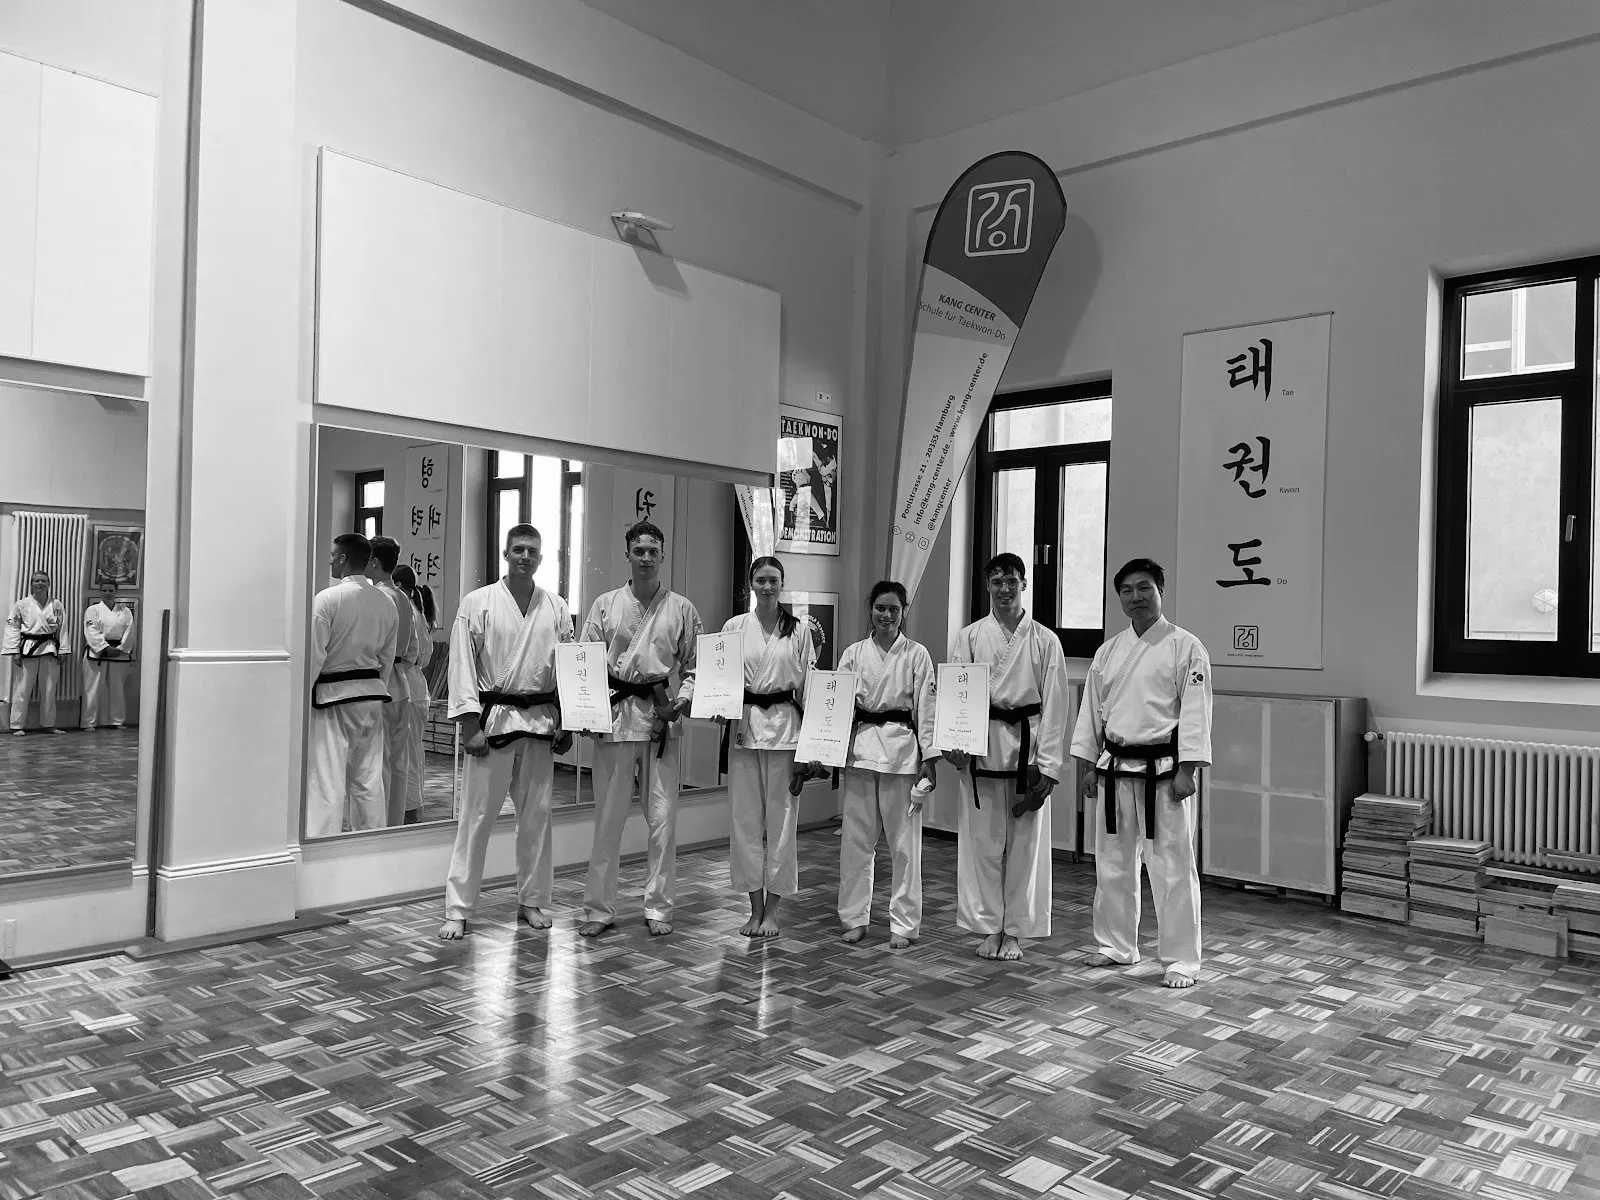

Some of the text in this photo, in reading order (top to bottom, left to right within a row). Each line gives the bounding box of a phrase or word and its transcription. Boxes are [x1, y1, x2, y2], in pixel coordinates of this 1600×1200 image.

[918, 301, 1006, 341] Schule für Taekwon-Do
[938, 294, 996, 322] KANG CENTER
[1226, 338, 1273, 402] 태
[781, 419, 838, 441] TAEKWON-DO
[914, 352, 988, 525] info@kang-center.de www.kang-center.de
[901, 395, 955, 520] Poolstrasse 21 20355 Hamburg
[1223, 436, 1271, 498] 권
[927, 478, 952, 531] @kangcenter
[1216, 538, 1271, 588] 도
[1276, 577, 1288, 585] Do
